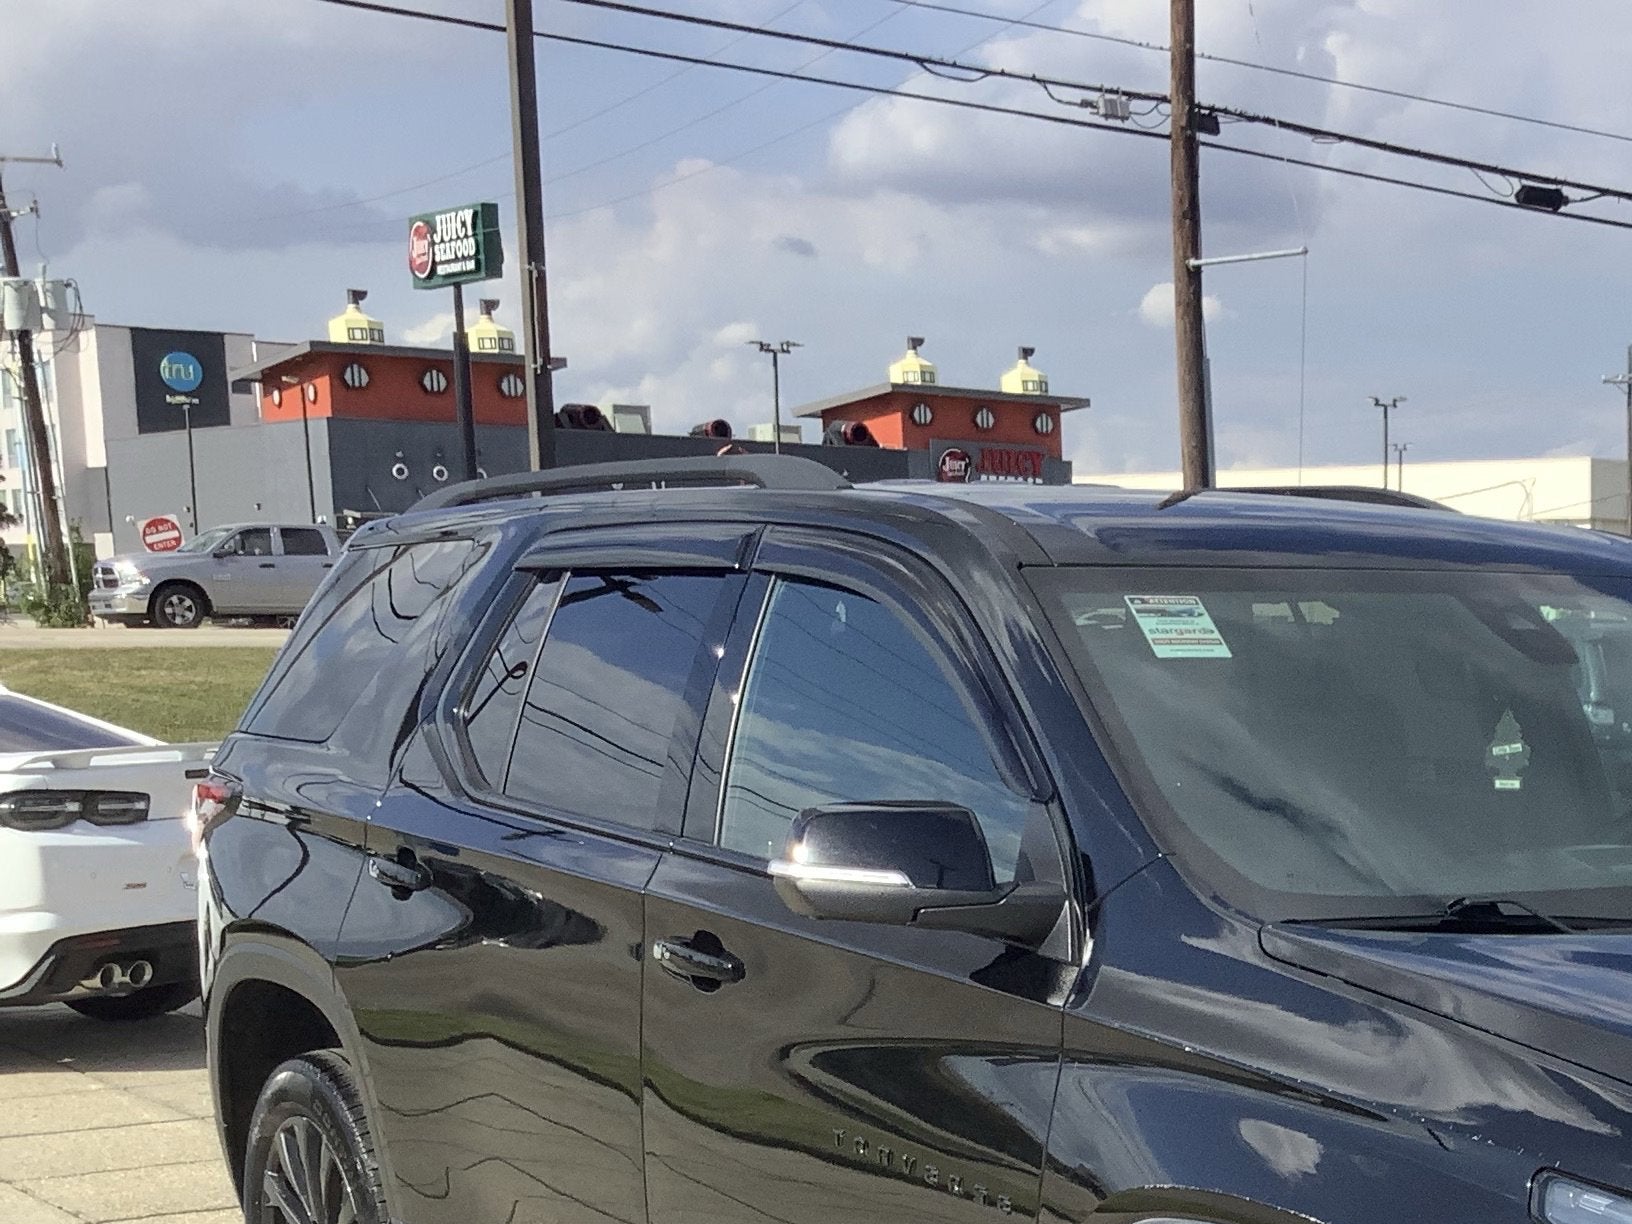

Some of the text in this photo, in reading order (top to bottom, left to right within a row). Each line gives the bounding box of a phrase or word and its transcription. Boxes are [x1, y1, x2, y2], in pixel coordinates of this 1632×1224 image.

[433, 208, 474, 243] JUICY
[434, 237, 476, 262] SEAFOOD
[145, 523, 172, 535] DO NOT
[153, 540, 177, 550] ENTER
